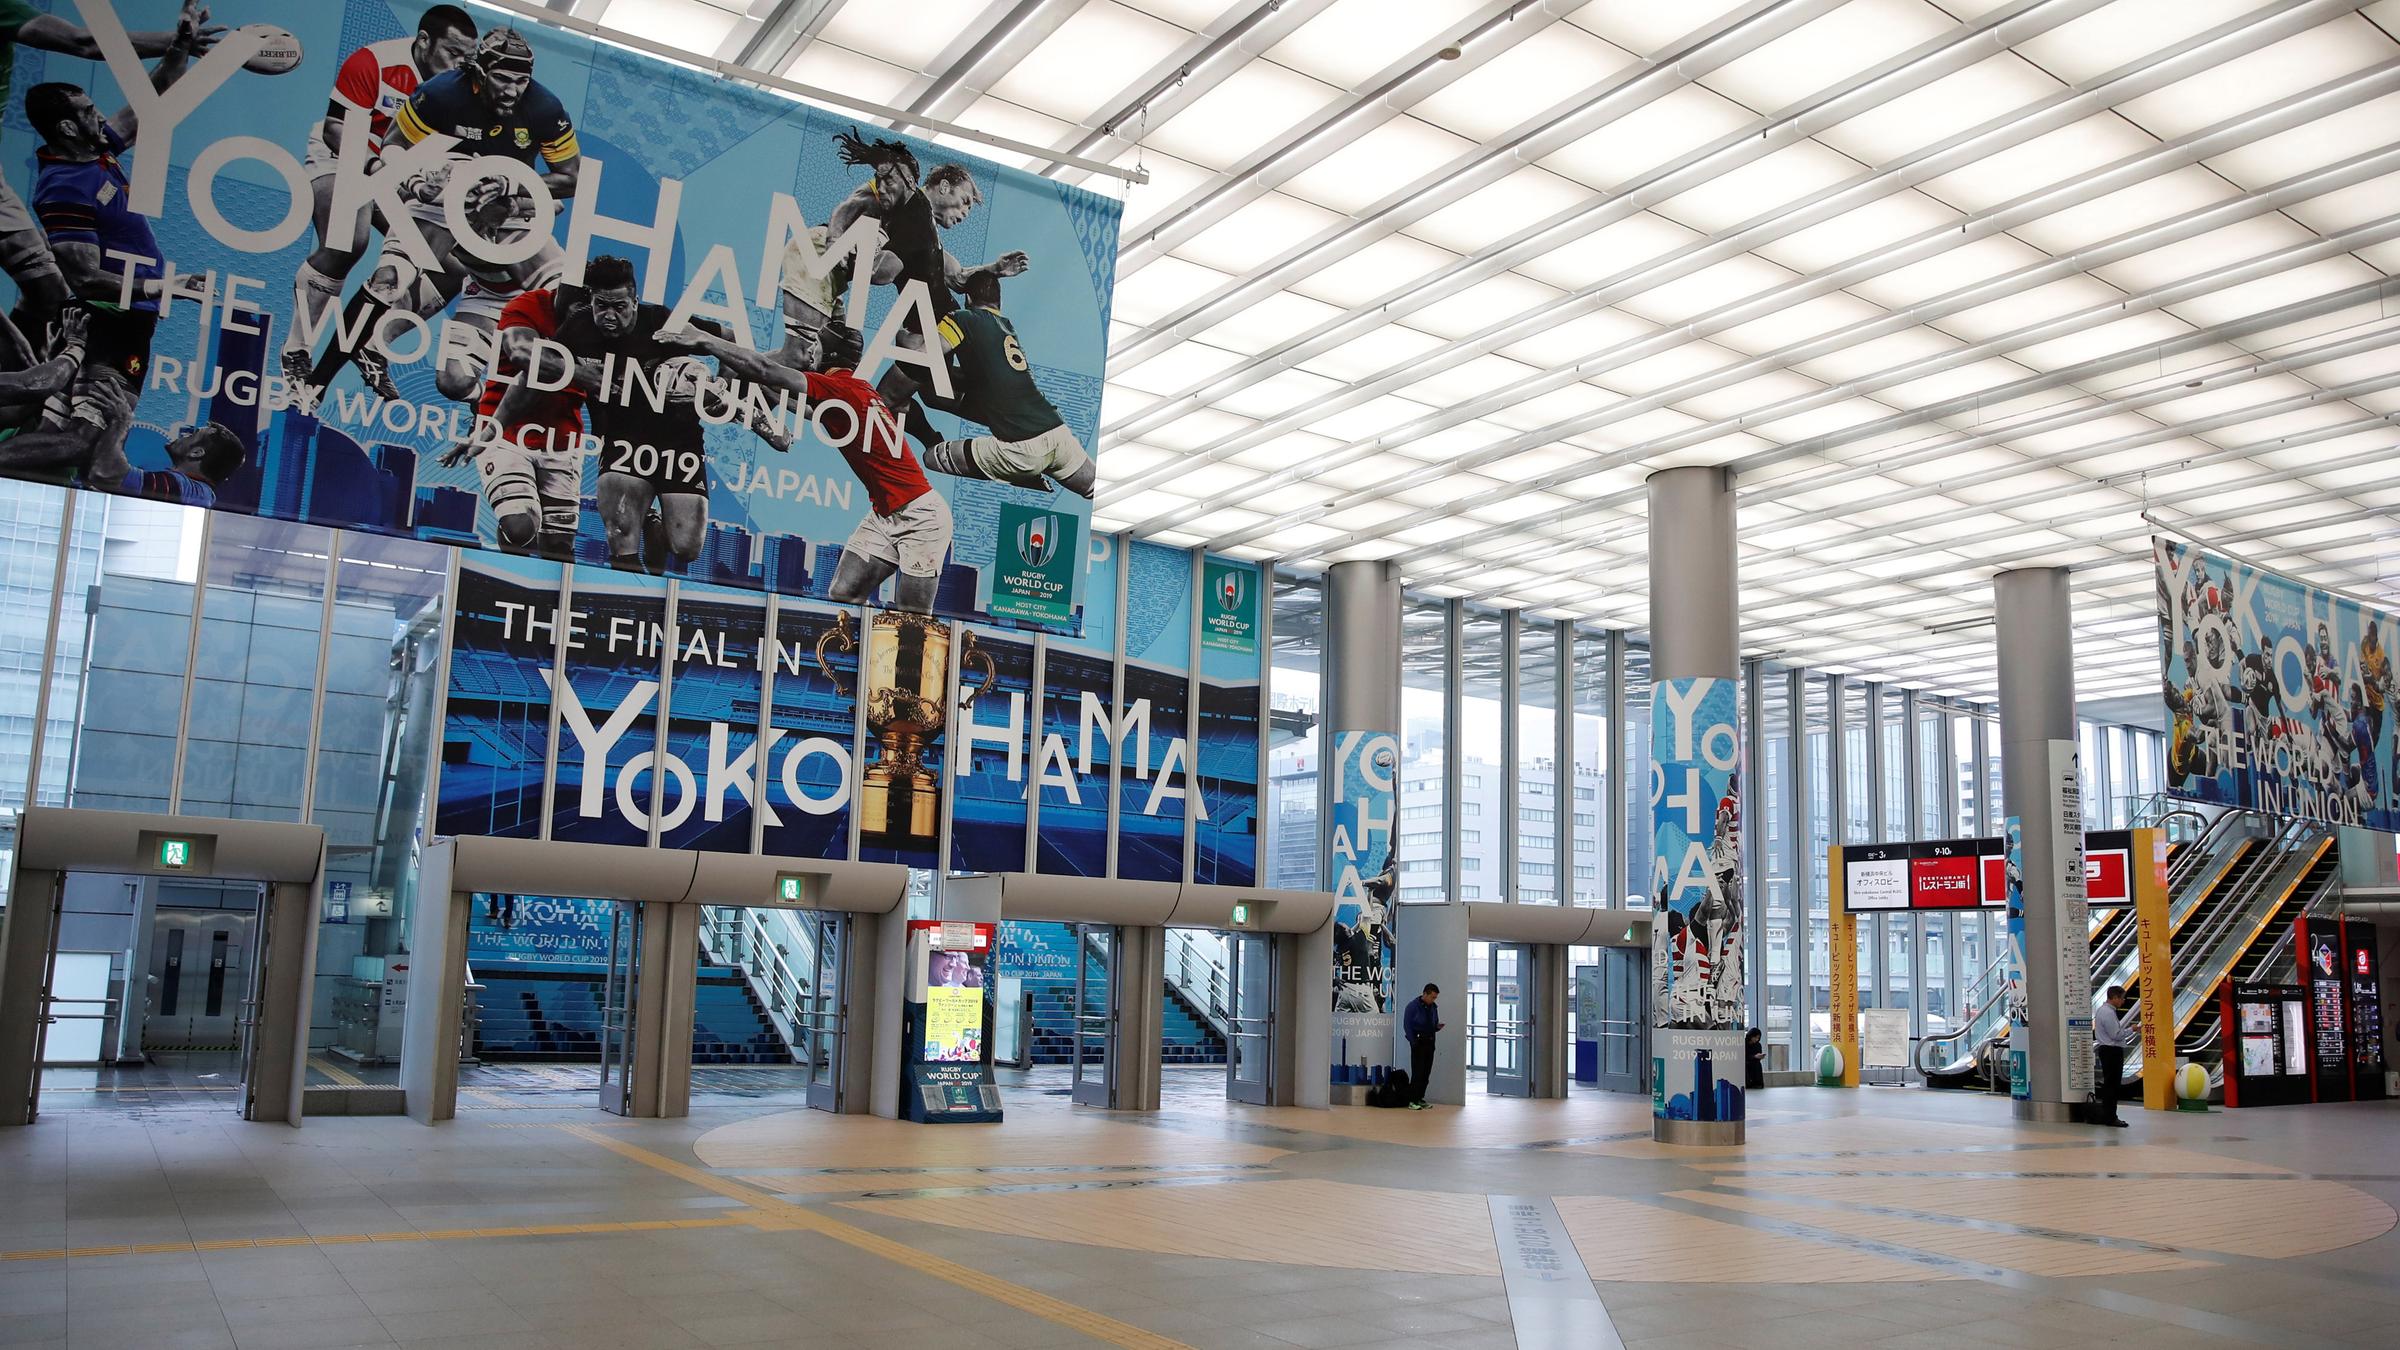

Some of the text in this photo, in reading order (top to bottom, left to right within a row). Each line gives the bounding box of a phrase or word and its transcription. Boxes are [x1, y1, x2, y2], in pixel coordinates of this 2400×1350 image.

[105, 249, 907, 459] THE WORLD IN UNION
[1002, 330, 1031, 372] 6
[151, 353, 326, 414] RUGBY
[335, 387, 504, 448] WORLD
[516, 421, 603, 462] CUP
[727, 461, 853, 511] JAPAN
[1021, 570, 1046, 580] RUGBY
[1003, 575, 1064, 592] WORLD CUP
[1011, 587, 1031, 596] JAPAN
[1015, 601, 1047, 611] HOST CITY
[1220, 613, 1238, 621] RUGBY
[1208, 617, 1250, 630] WORLD CUP
[494, 600, 802, 676] THE FINAL IN
[2203, 726, 2337, 783] THE WORLD
[2257, 781, 2363, 828] IN UNION
[1856, 879, 1899, 887] オフィスロビー
[1922, 880, 1966, 890] レストラン街
[539, 953, 571, 962] WORLD
[571, 954, 589, 963] CUP
[590, 956, 608, 964] 2019
[1831, 922, 1841, 1042] キュービックプラザ新横浜
[2140, 918, 2157, 1058] キュービックプラザ新横浜
[1355, 1028, 1383, 1038] JAPAN
[1672, 1035, 1712, 1046] RUGBY
[1705, 1050, 1738, 1061] JAPAN
[926, 1072, 961, 1080] WORLD
